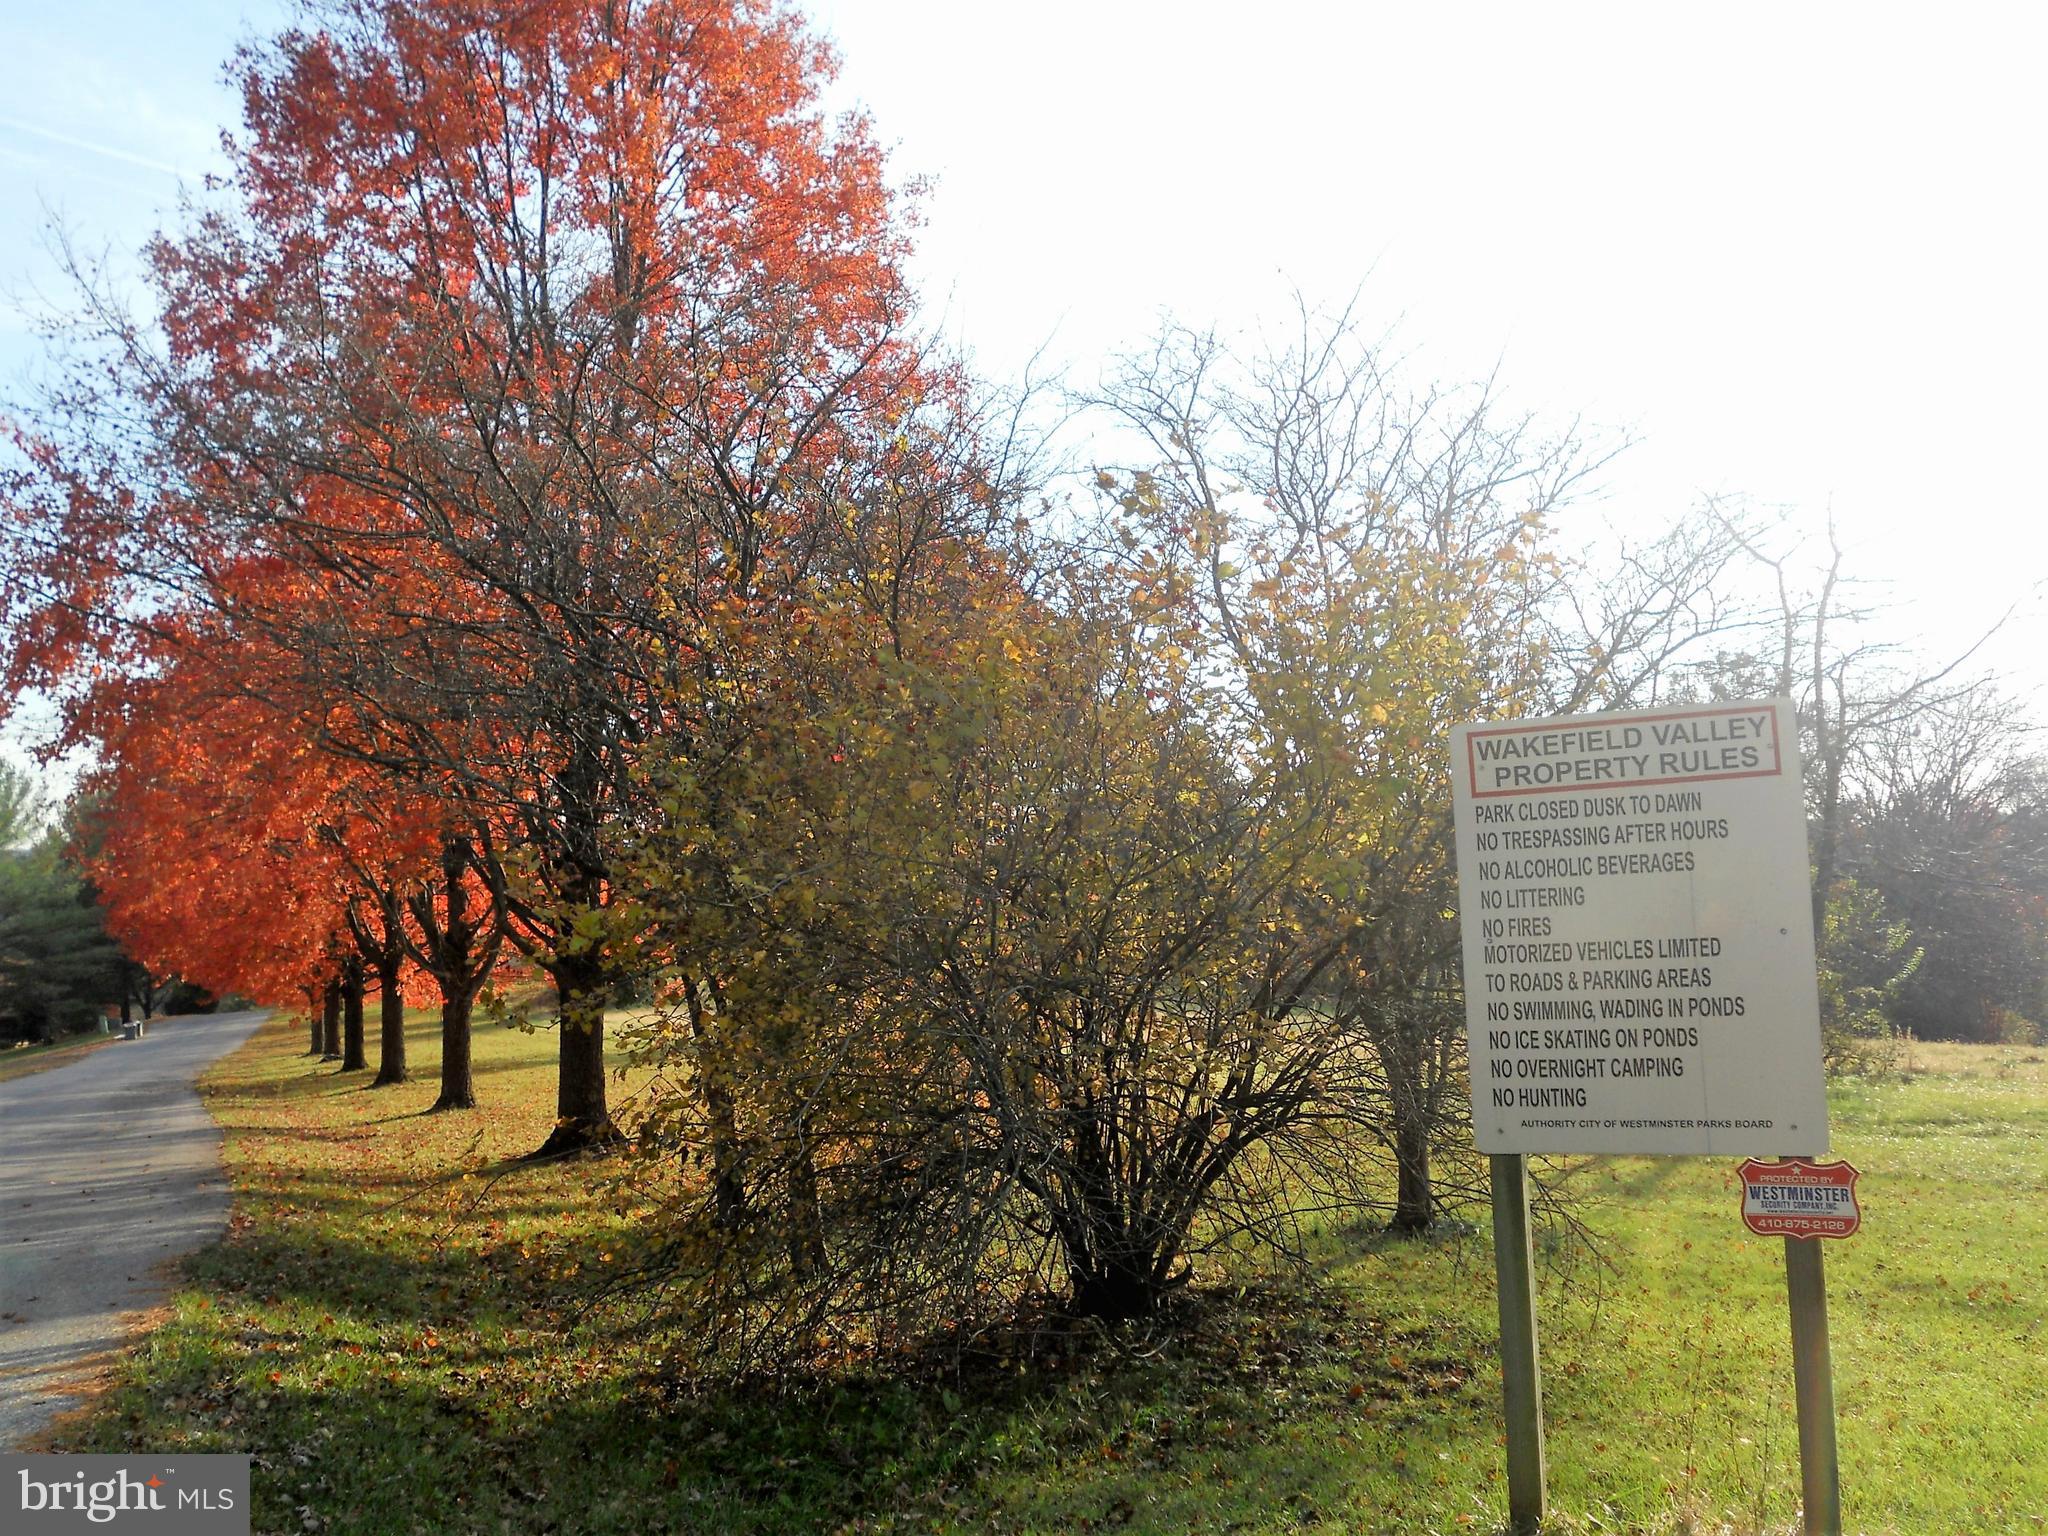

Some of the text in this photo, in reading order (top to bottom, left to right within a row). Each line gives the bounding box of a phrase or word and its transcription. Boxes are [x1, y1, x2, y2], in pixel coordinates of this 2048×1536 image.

[1477, 716, 1767, 761] WAKEFIELD VALLEY
[1495, 746, 1759, 787] PROPERTY RULES
[1476, 792, 1701, 824] PARK CLOSED DUSK TO DAWN
[1477, 819, 1728, 851] NO TRESPASSING AFTER HOURS
[1479, 852, 1695, 880] NO ALCOHOLIC BEVERAGES
[1481, 886, 1584, 909] NO LITTERING
[1482, 918, 1551, 938] NO FIRES
[1485, 937, 1721, 964] MOTORIZED VEHICLES LIMITED
[1486, 967, 1712, 992] TO ROADS & PARKING AREAS
[1488, 996, 1745, 1022] NO SWIMMING, WADING IN PONDS
[1489, 1027, 1698, 1049] NO ICE SKATING ON PONDS
[1491, 1057, 1683, 1078] NO OVERNIGHT CAMPING
[1493, 1087, 1586, 1107] NO HUNTING
[1521, 1119, 1773, 1129] AUTHORITY CITY OF WESTMINSTER PARKS BOARD
[1760, 1175, 1817, 1183] PROTECTED
[1749, 1186, 1849, 1202] WESTMINSTER
